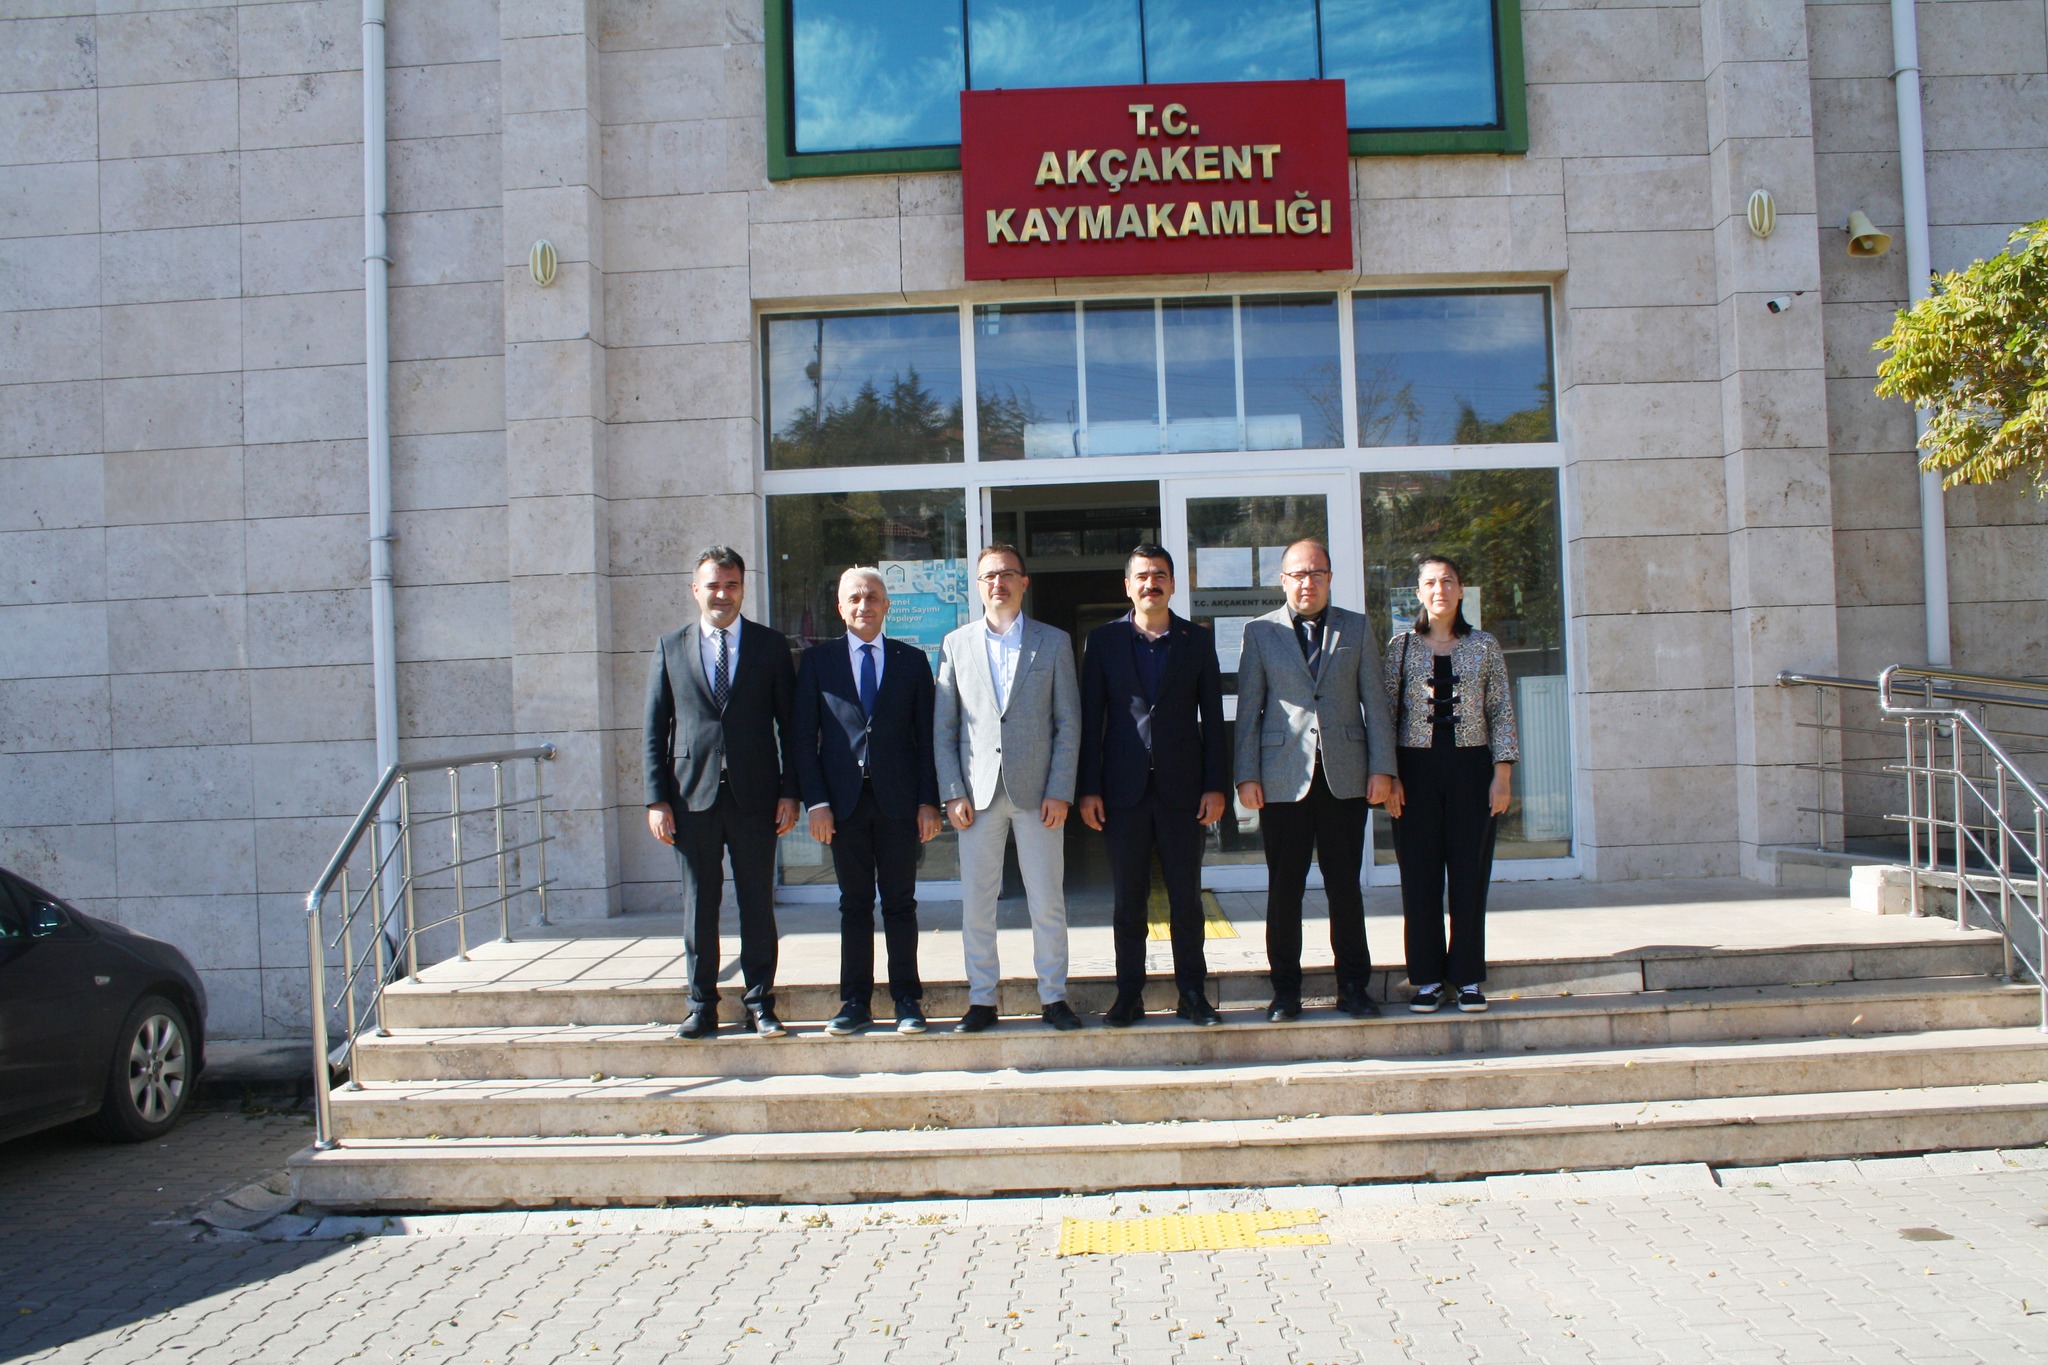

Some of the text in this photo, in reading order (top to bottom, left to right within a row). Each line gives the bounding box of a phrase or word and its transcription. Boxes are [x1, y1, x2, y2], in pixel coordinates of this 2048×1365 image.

[1128, 103, 1199, 136] T.C.
[1034, 144, 1281, 193] AKÇAKENT
[986, 190, 1332, 244] KAYMAKAMLIĞI
[1211, 599, 1259, 608] AKÇAKENT
